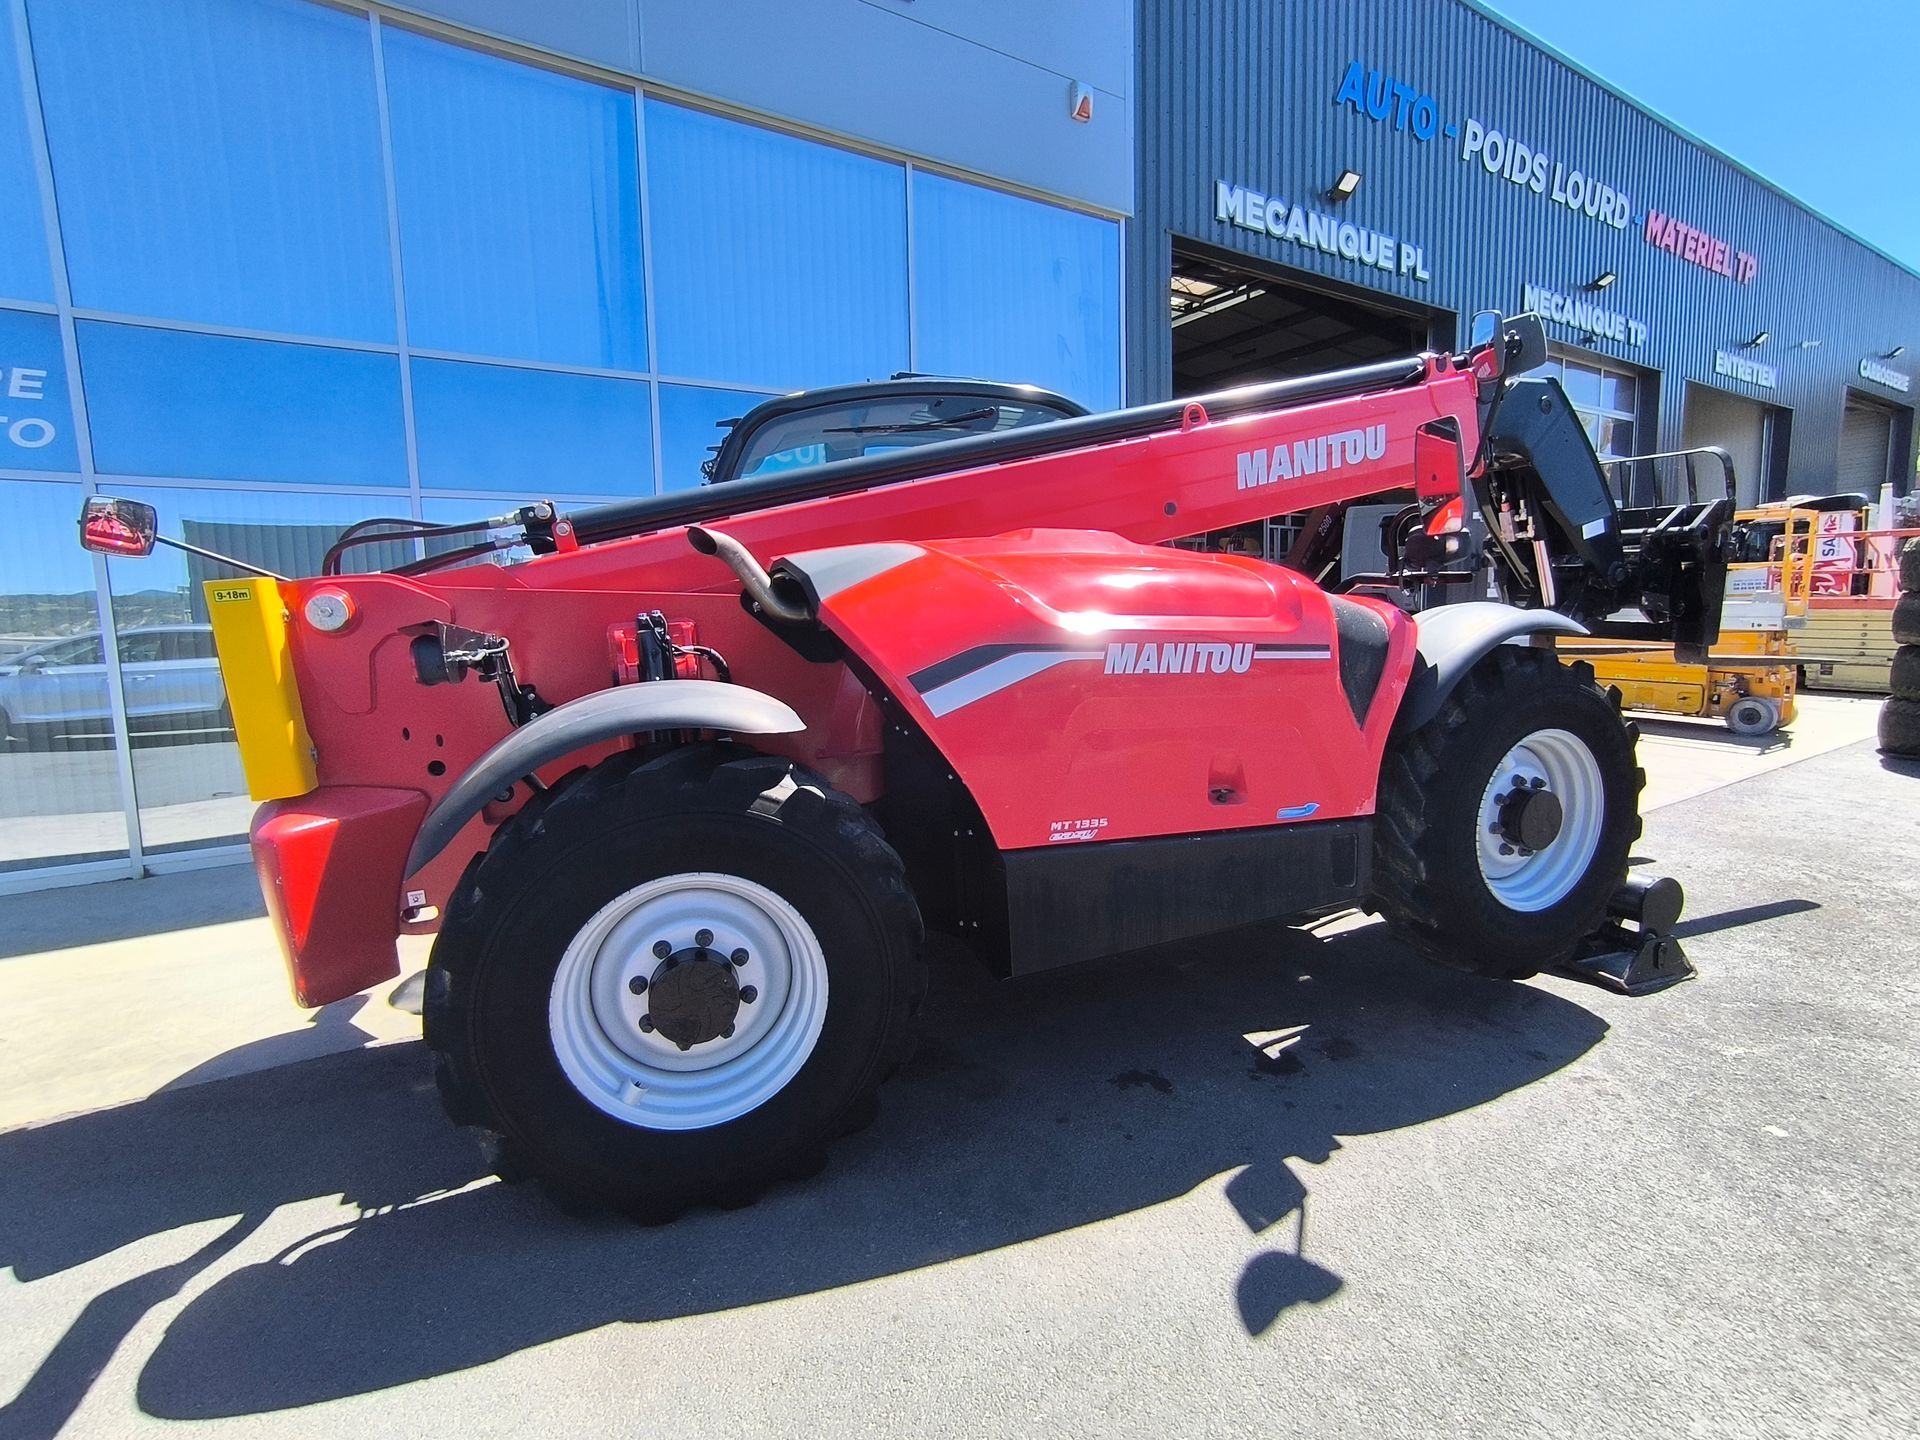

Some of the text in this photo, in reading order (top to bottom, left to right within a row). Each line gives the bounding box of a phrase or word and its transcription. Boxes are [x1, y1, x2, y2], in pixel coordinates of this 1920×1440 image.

[1336, 60, 1437, 141] AUTO
[1462, 118, 1549, 194] POIDS
[1551, 161, 1631, 230] LOURD
[1644, 208, 1734, 278] MATERIEL
[1735, 250, 1758, 285] TP
[1216, 180, 1430, 280] MECANIQUE PL
[1523, 283, 1648, 348] MECANIQUE TP
[0, 367, 48, 400] E
[1715, 349, 1777, 389] ENTRETIEN
[1237, 424, 1386, 490] MANITOU
[216, 590, 249, 601] 9-18m
[1103, 642, 1255, 675] MANITOU
[1050, 818, 1109, 832] MT 1335
